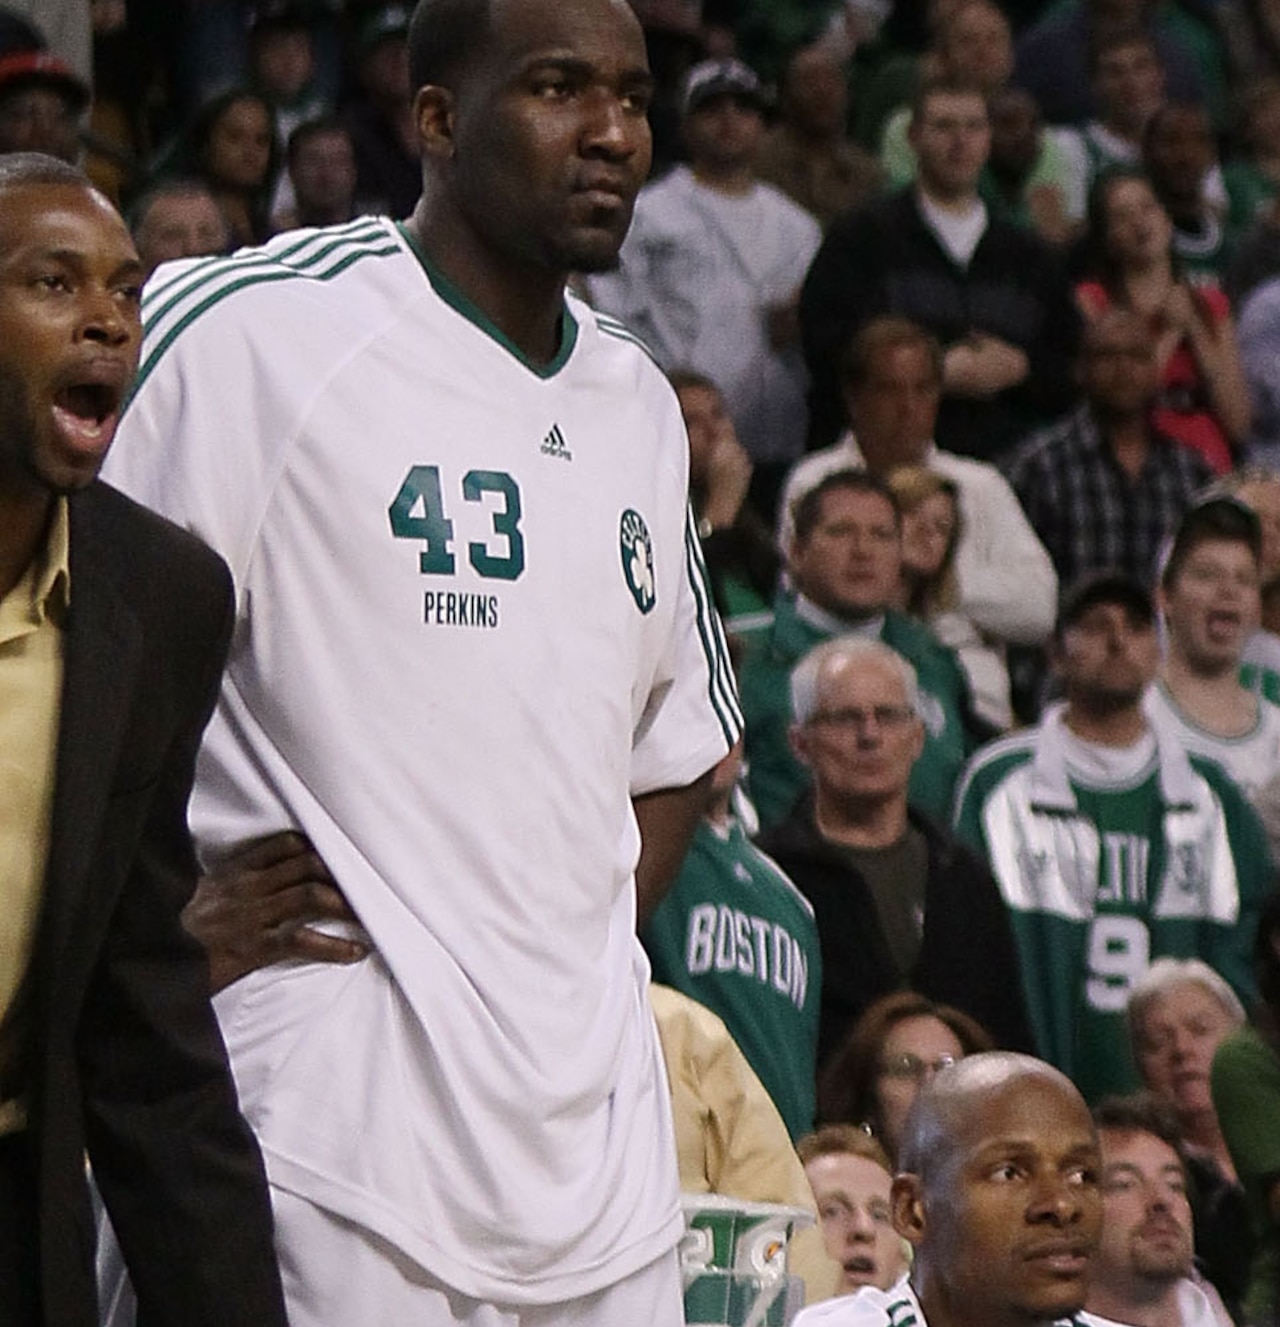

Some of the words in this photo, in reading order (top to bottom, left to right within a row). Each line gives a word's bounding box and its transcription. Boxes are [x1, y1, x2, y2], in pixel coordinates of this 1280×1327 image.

[388, 464, 526, 582] 43
[423, 591, 499, 628] PERKINS
[687, 901, 809, 1010] BOSTON
[1086, 915, 1150, 1011] 9
